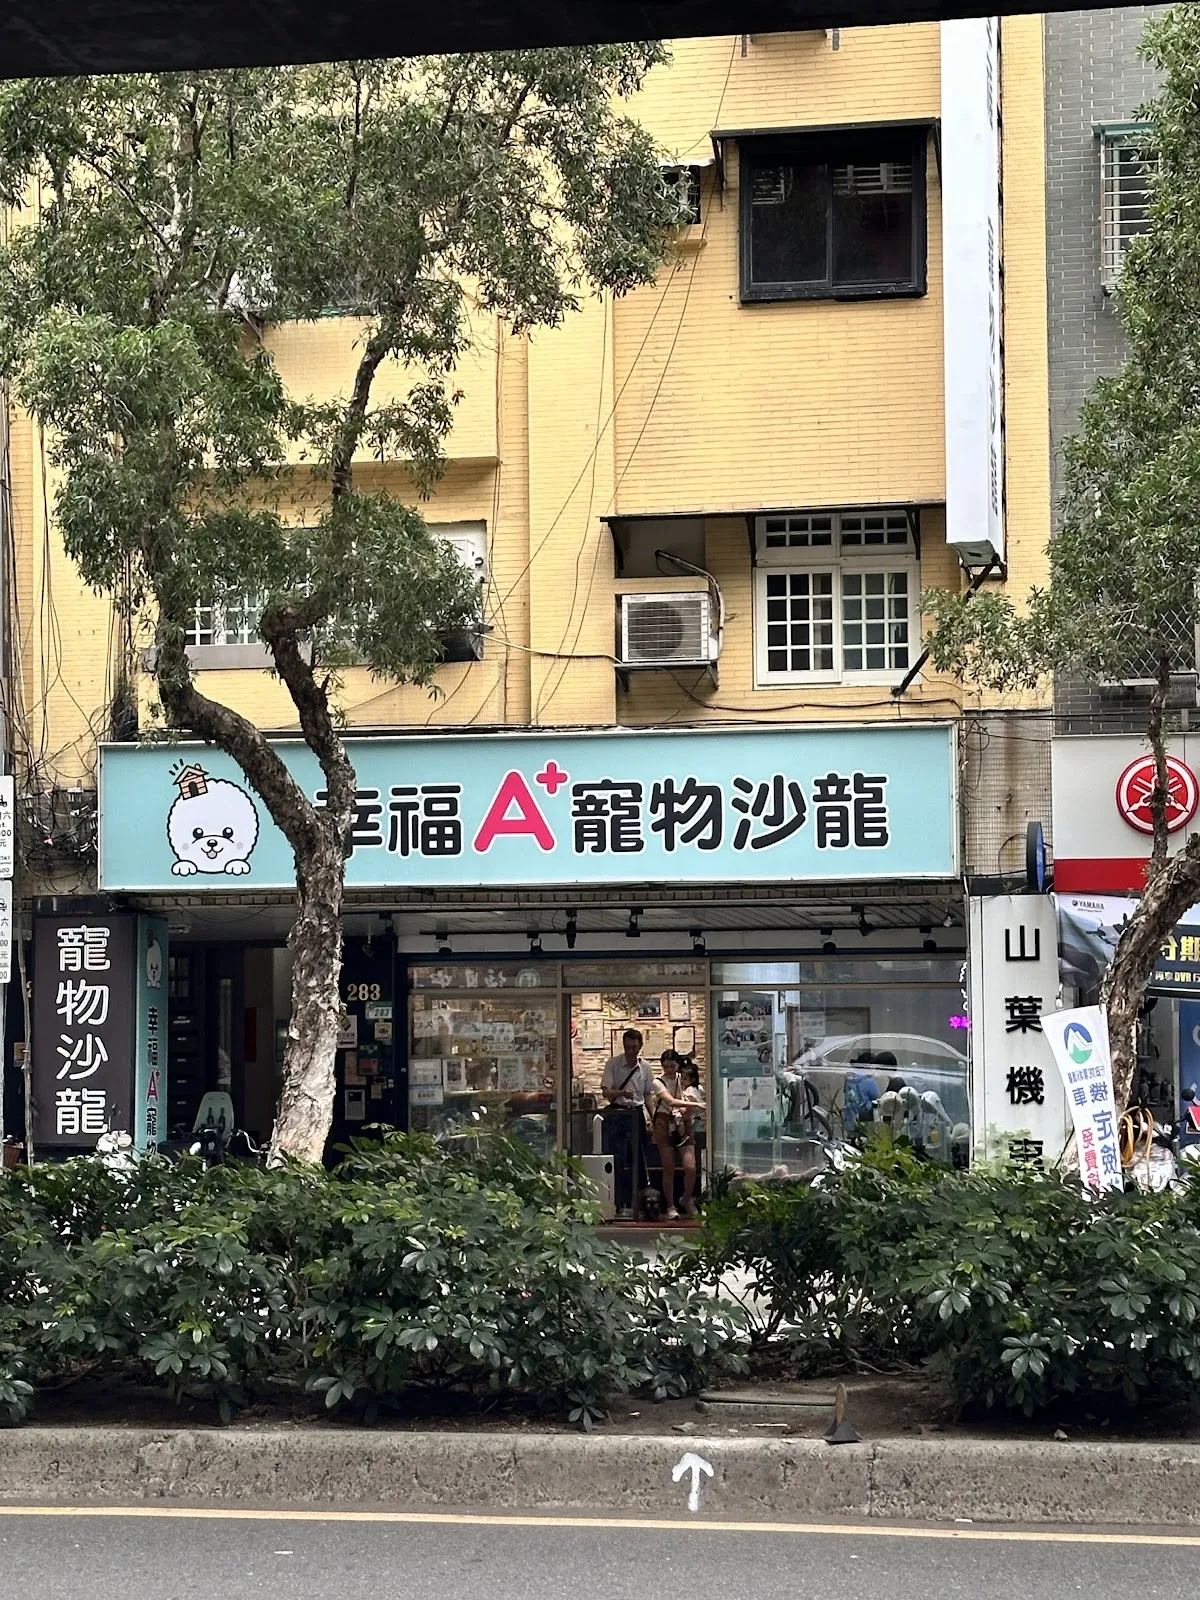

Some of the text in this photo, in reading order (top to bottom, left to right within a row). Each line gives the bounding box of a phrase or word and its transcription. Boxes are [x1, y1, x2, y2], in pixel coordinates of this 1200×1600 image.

[1079, 900, 1105, 910] YAMAHA
[347, 983, 381, 1001] 283
[374, 1008, 390, 1017] 283
[55, 924, 111, 1135] 寵物沙龍
